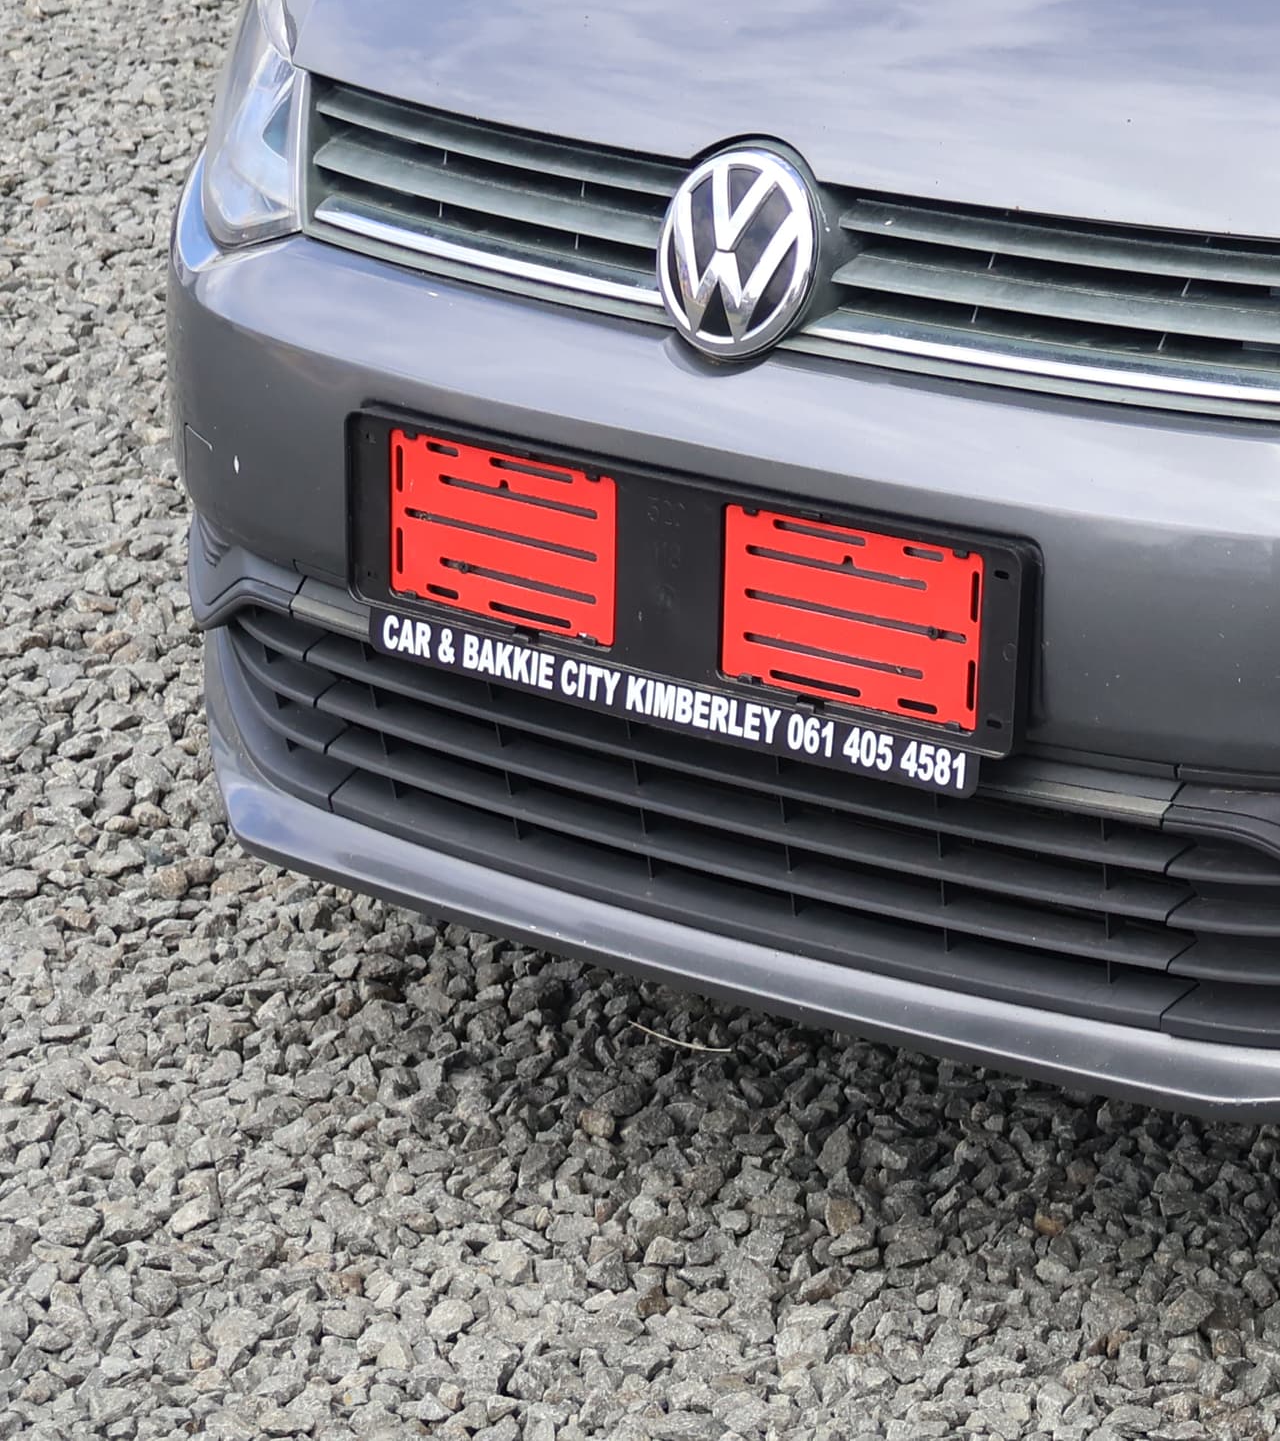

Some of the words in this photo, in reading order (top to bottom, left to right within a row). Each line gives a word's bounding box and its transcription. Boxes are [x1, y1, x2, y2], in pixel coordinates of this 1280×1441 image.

[382, 614, 431, 659] CAR
[437, 628, 456, 665] &
[462, 633, 555, 690] BAKKIE
[560, 659, 621, 706] CITY
[625, 675, 782, 744] KIMBERLEY
[787, 713, 835, 758] 061
[843, 726, 894, 771] 405
[900, 741, 967, 789] 4581
